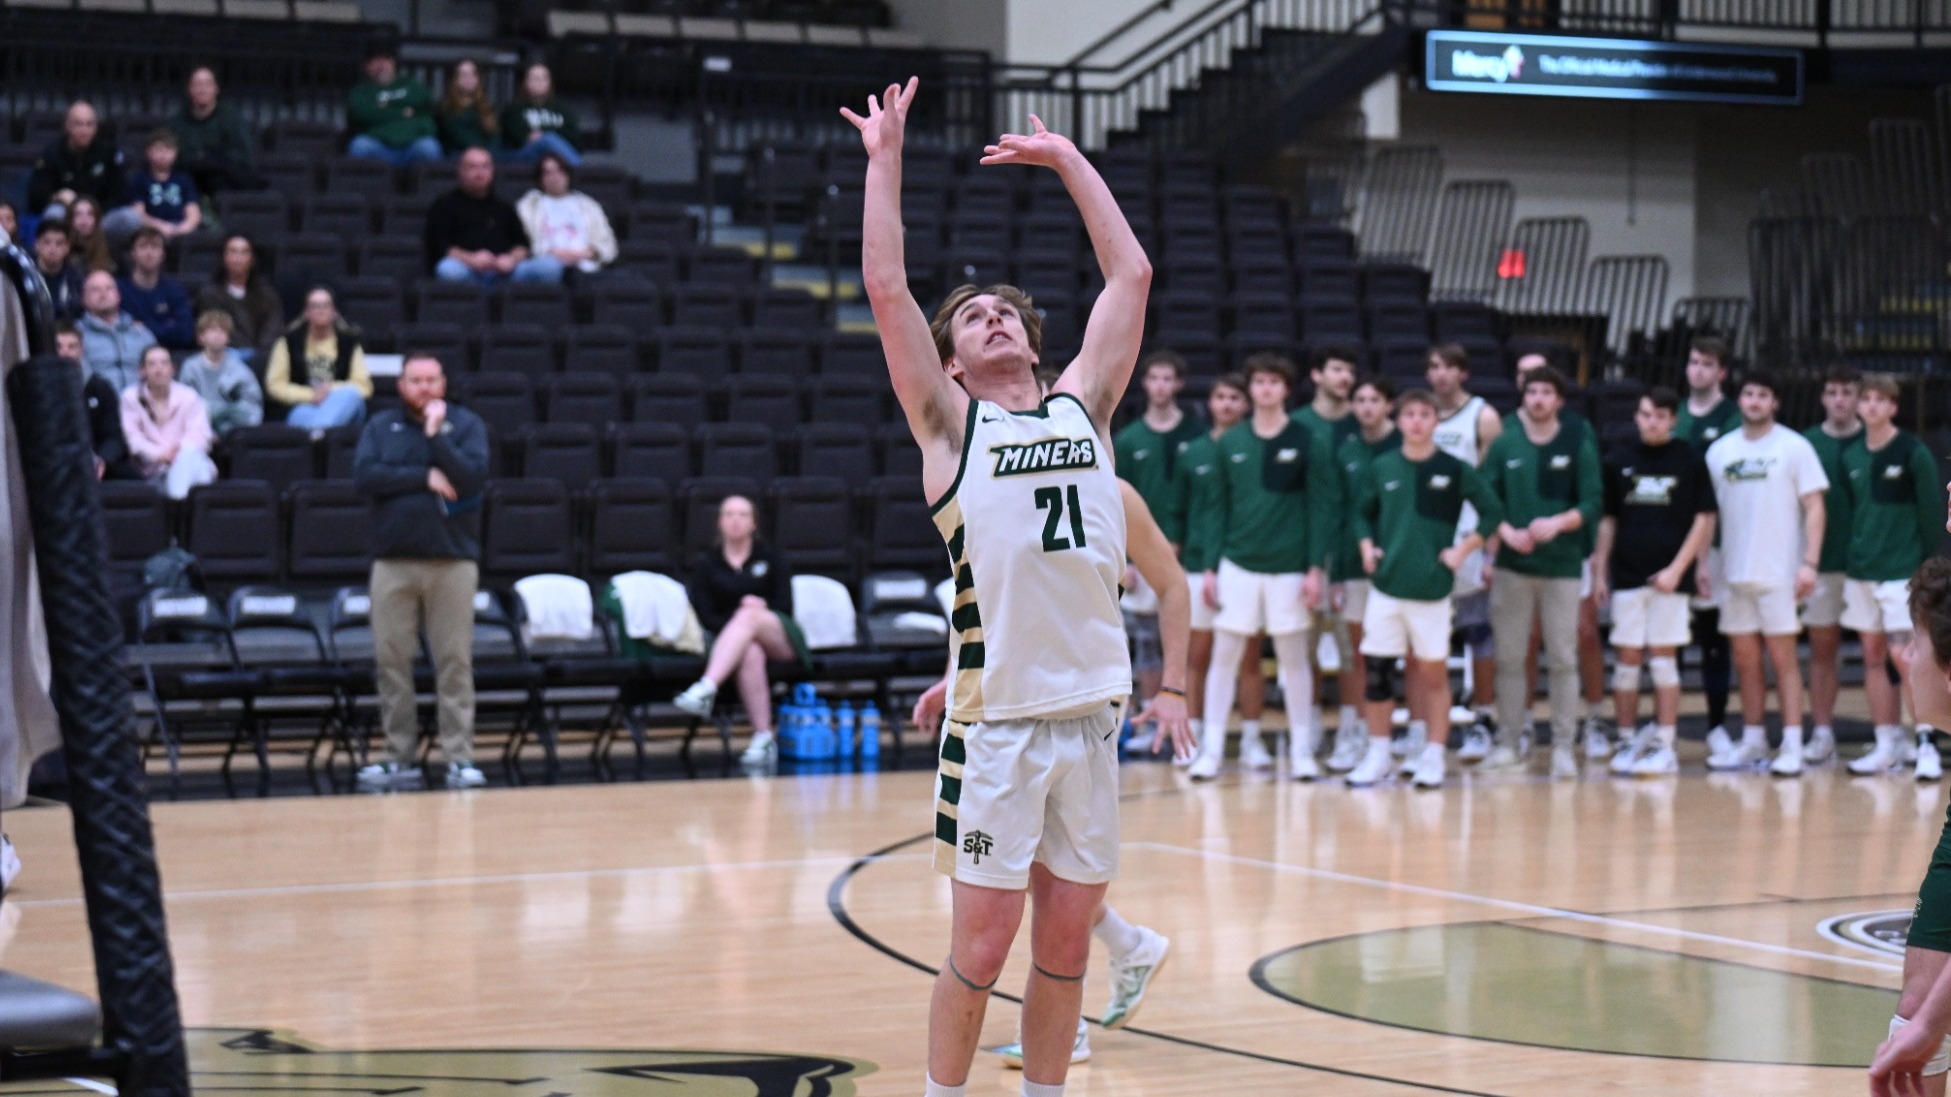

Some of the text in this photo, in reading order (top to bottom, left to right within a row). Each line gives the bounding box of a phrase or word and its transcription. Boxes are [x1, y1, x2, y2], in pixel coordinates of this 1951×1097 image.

[996, 440, 1094, 474] MINERS
[1034, 484, 1087, 552] 21
[963, 837, 994, 856] S&T
